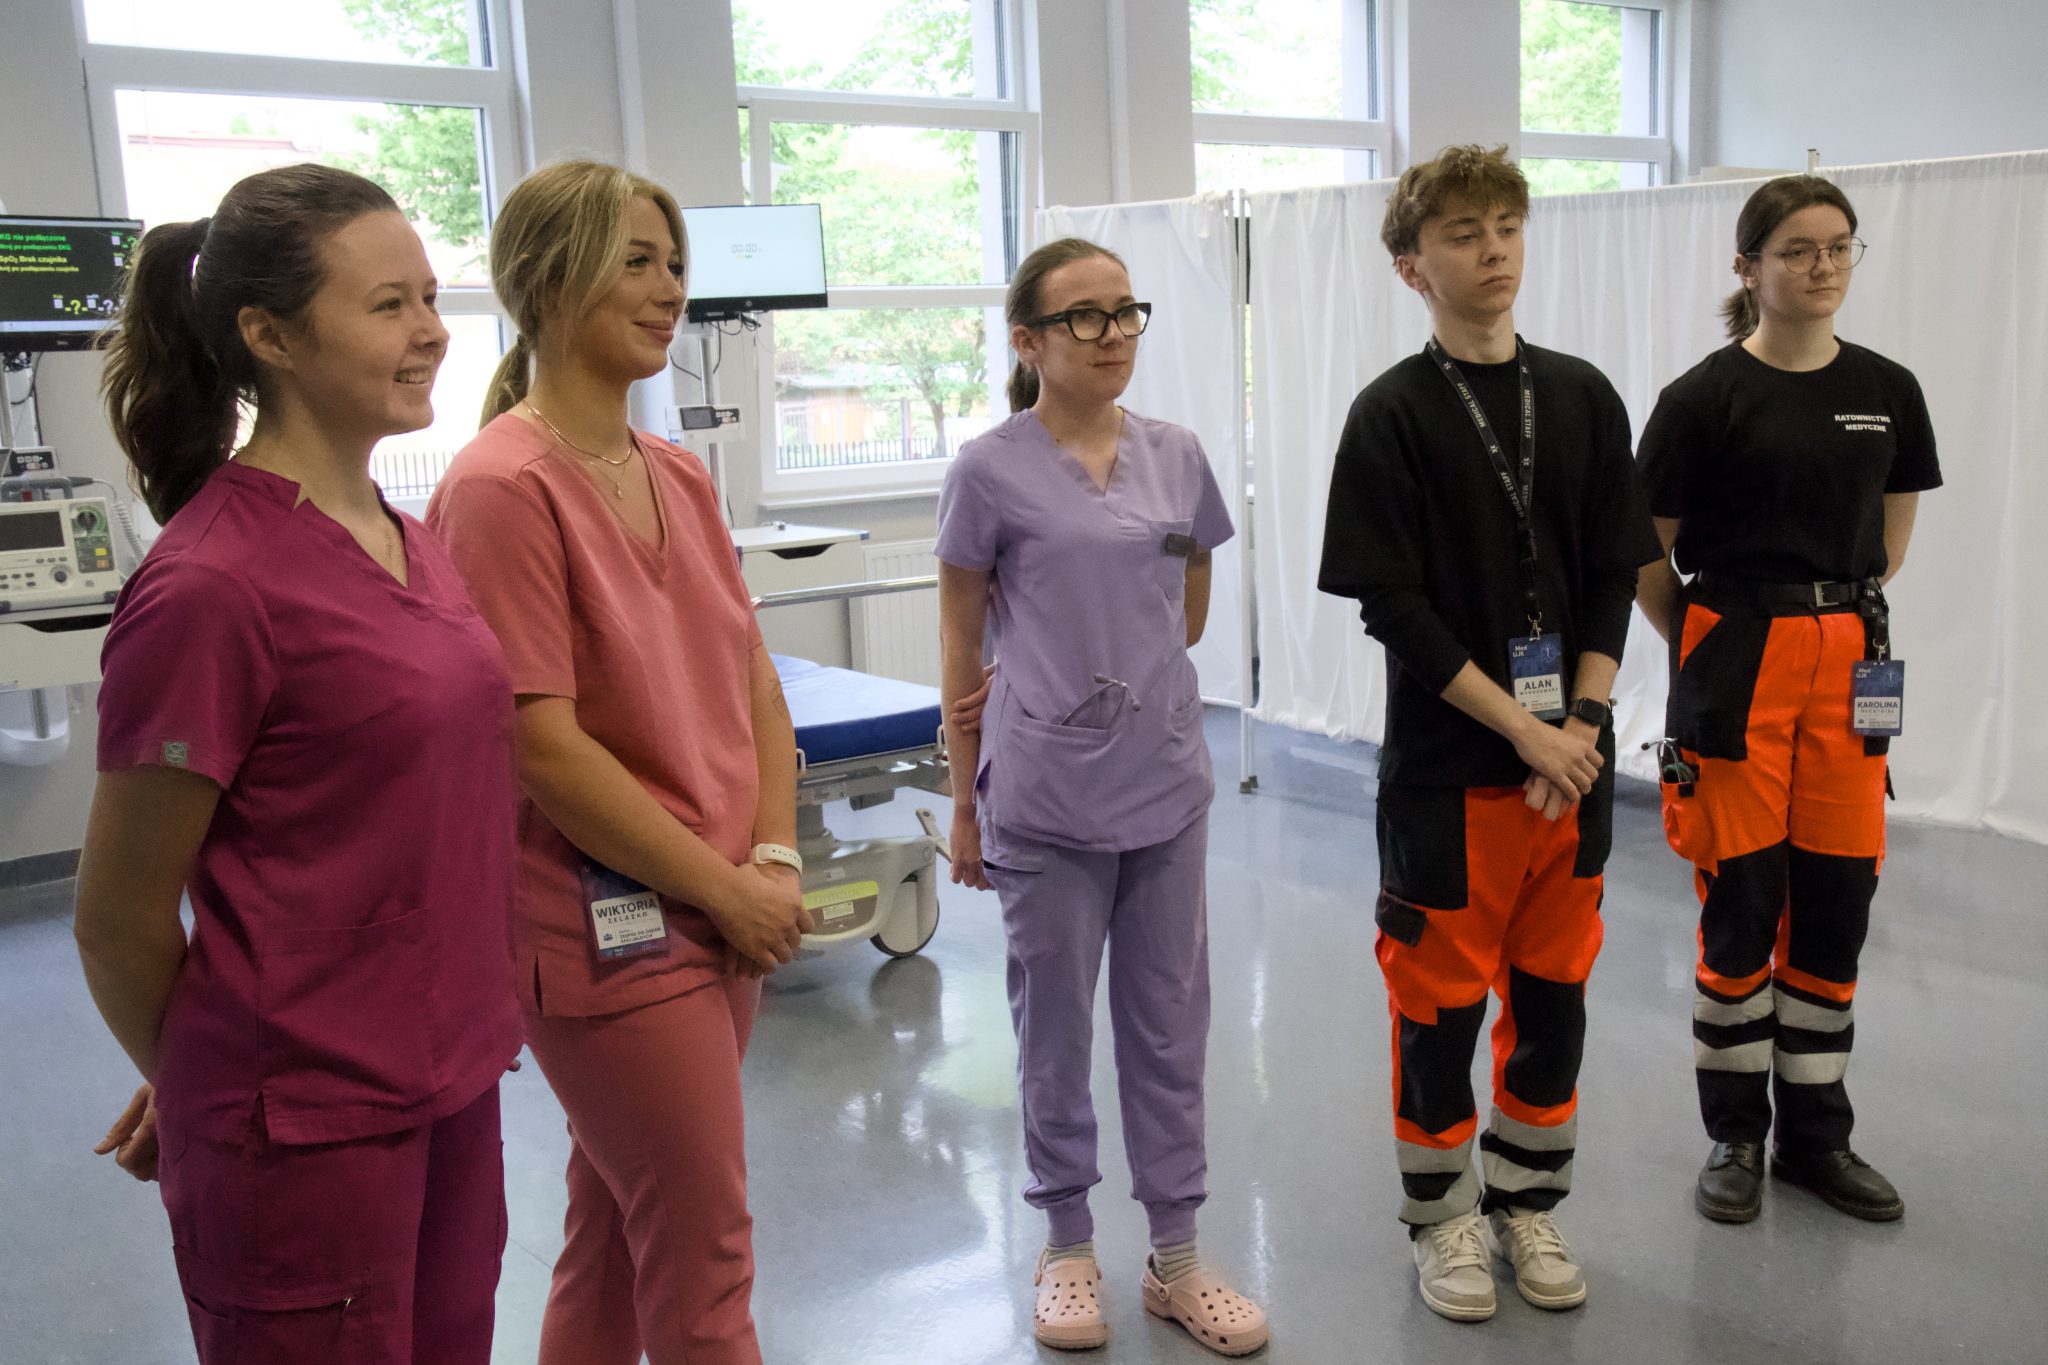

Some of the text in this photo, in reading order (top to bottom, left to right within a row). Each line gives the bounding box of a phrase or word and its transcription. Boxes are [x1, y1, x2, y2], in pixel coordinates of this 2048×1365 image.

[1457, 382, 1487, 428] MEDICAL STAFF
[1524, 389, 1532, 419] MEDICAL
[1834, 414, 1891, 423] RATOWNICTWO
[1845, 424, 1887, 432] MEDYCZNE
[1524, 679, 1552, 691] ALAN
[1857, 701, 1898, 709] KAROLINA
[596, 899, 656, 919] WIKTORIA
